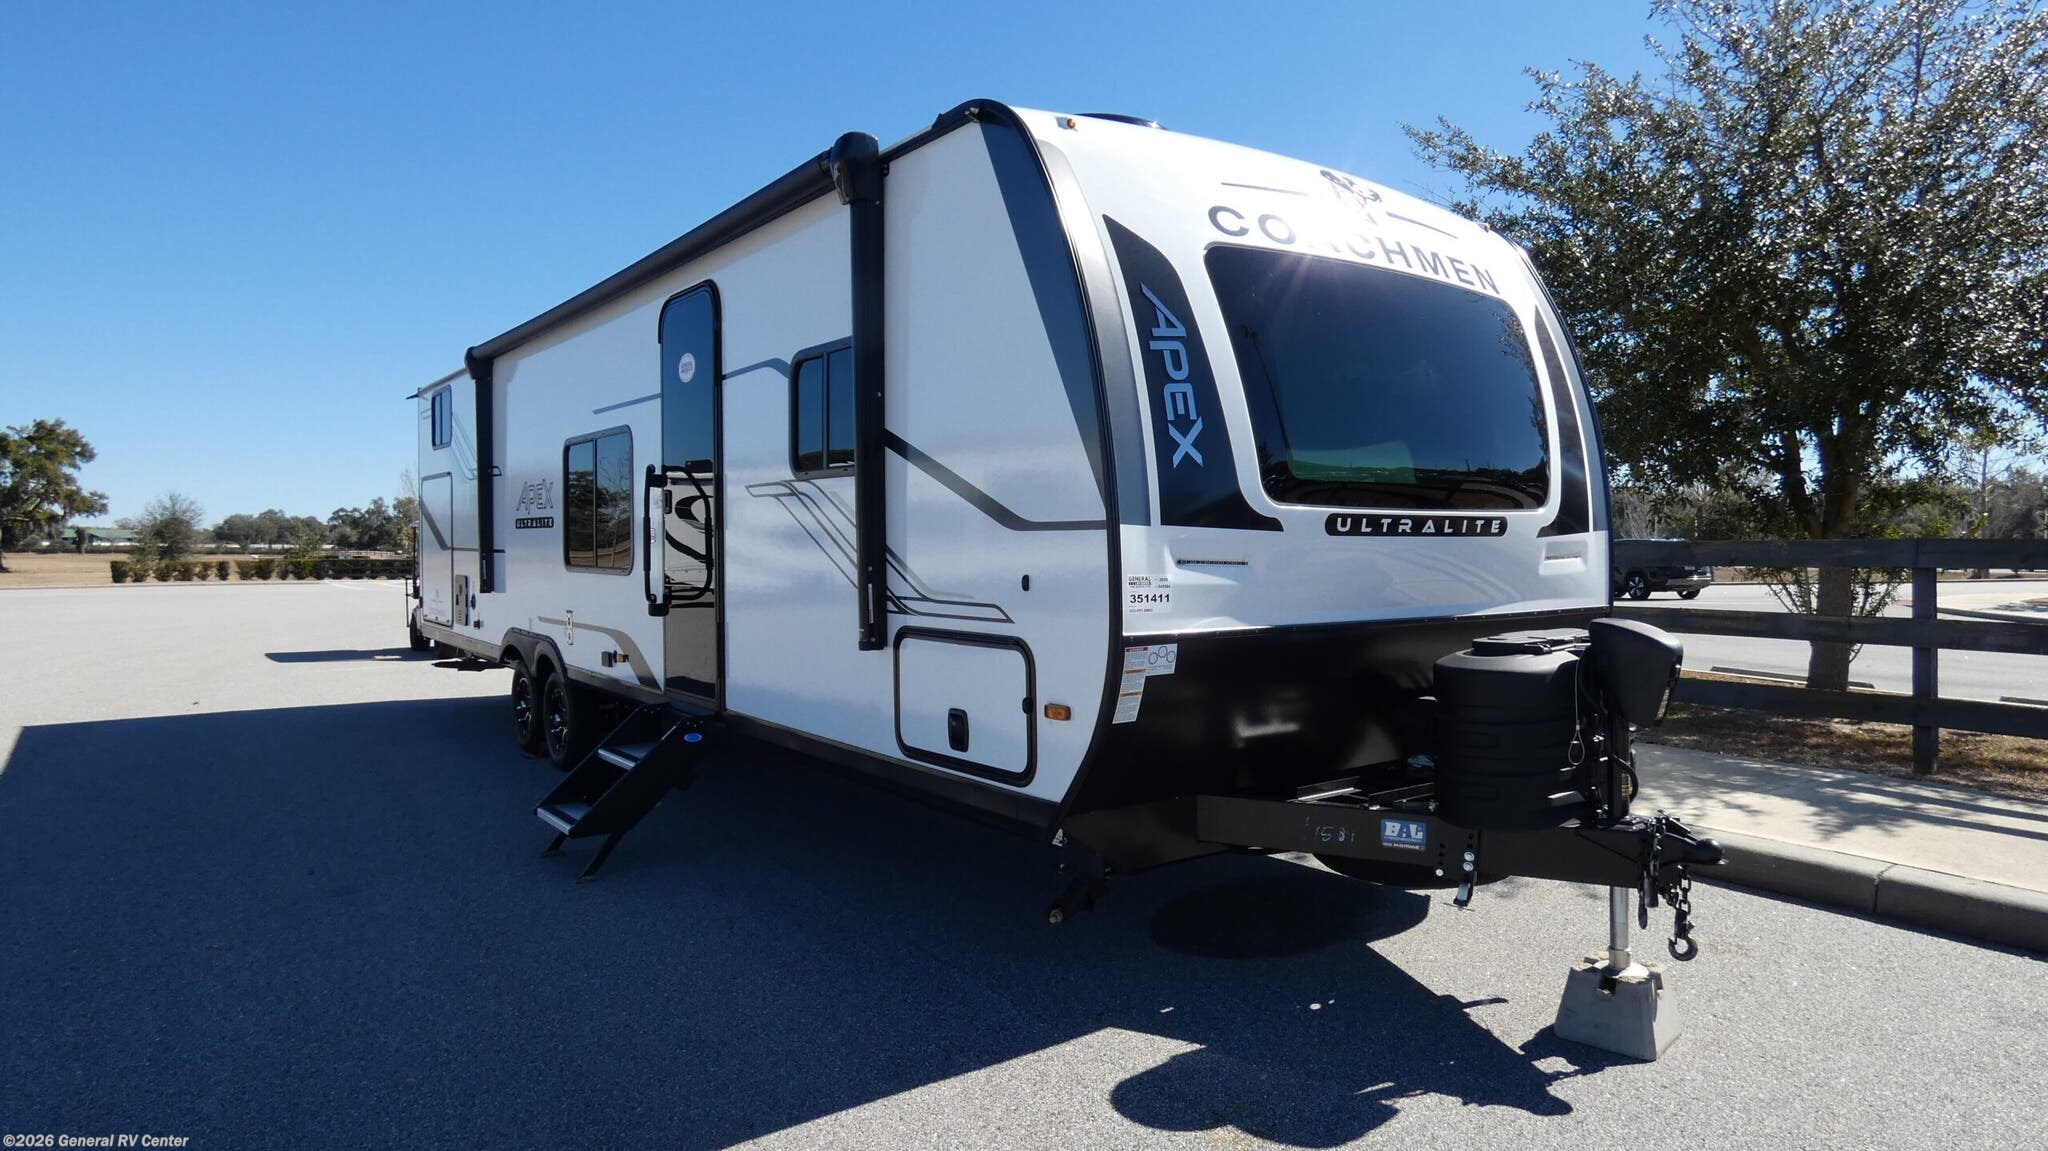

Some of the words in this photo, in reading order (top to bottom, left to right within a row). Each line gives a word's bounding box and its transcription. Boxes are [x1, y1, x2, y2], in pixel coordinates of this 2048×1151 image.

[1208, 205, 1499, 295] COCHMEN
[1140, 281, 1204, 468] APEX
[516, 479, 553, 514] APEX
[517, 519, 553, 528] ULTRALITE
[1336, 517, 1502, 533] ULTRALITE
[1130, 594, 1170, 603] 351411
